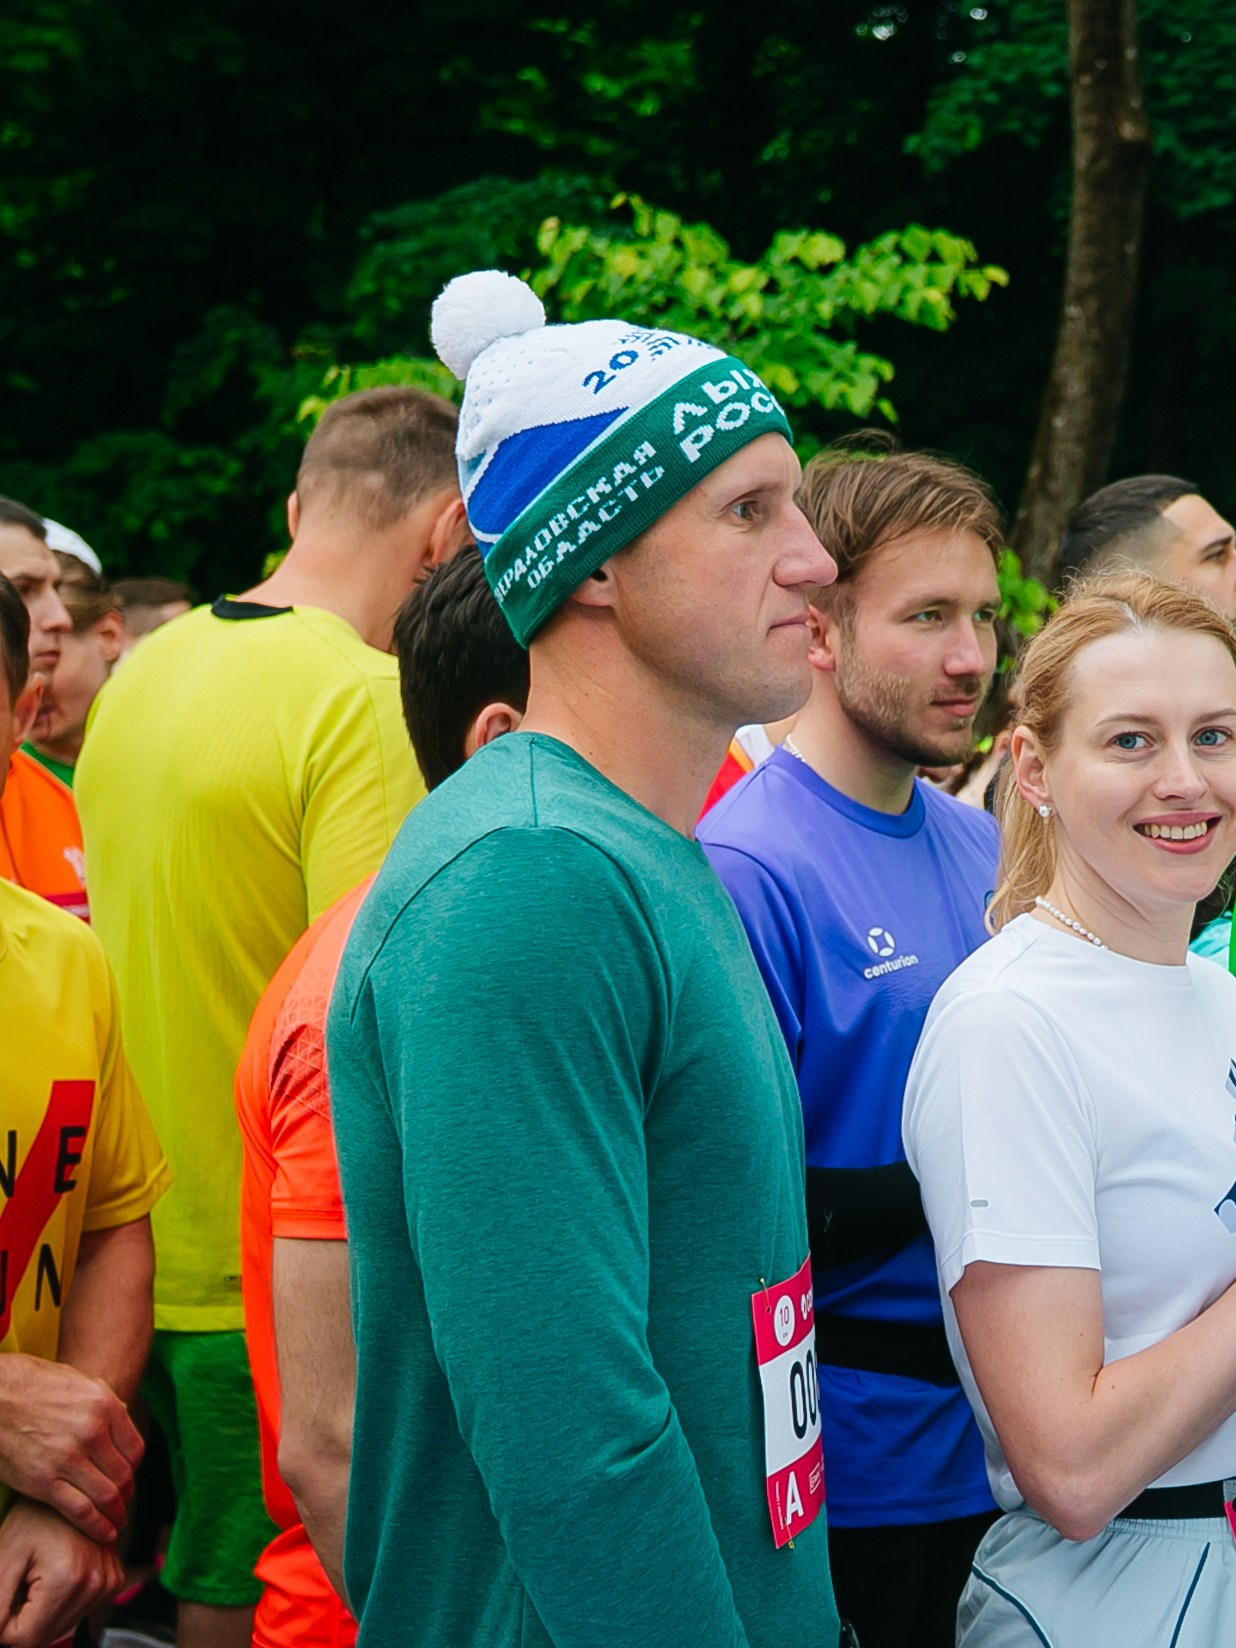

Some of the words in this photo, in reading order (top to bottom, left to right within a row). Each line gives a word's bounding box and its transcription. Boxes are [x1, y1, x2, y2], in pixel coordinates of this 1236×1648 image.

[680, 392, 785, 463] РОС
[527, 466, 665, 589] ОБЛАСТЬ
[864, 954, 919, 979] centurion
[780, 1305, 790, 1327] 10
[789, 1348, 821, 1440] 00
